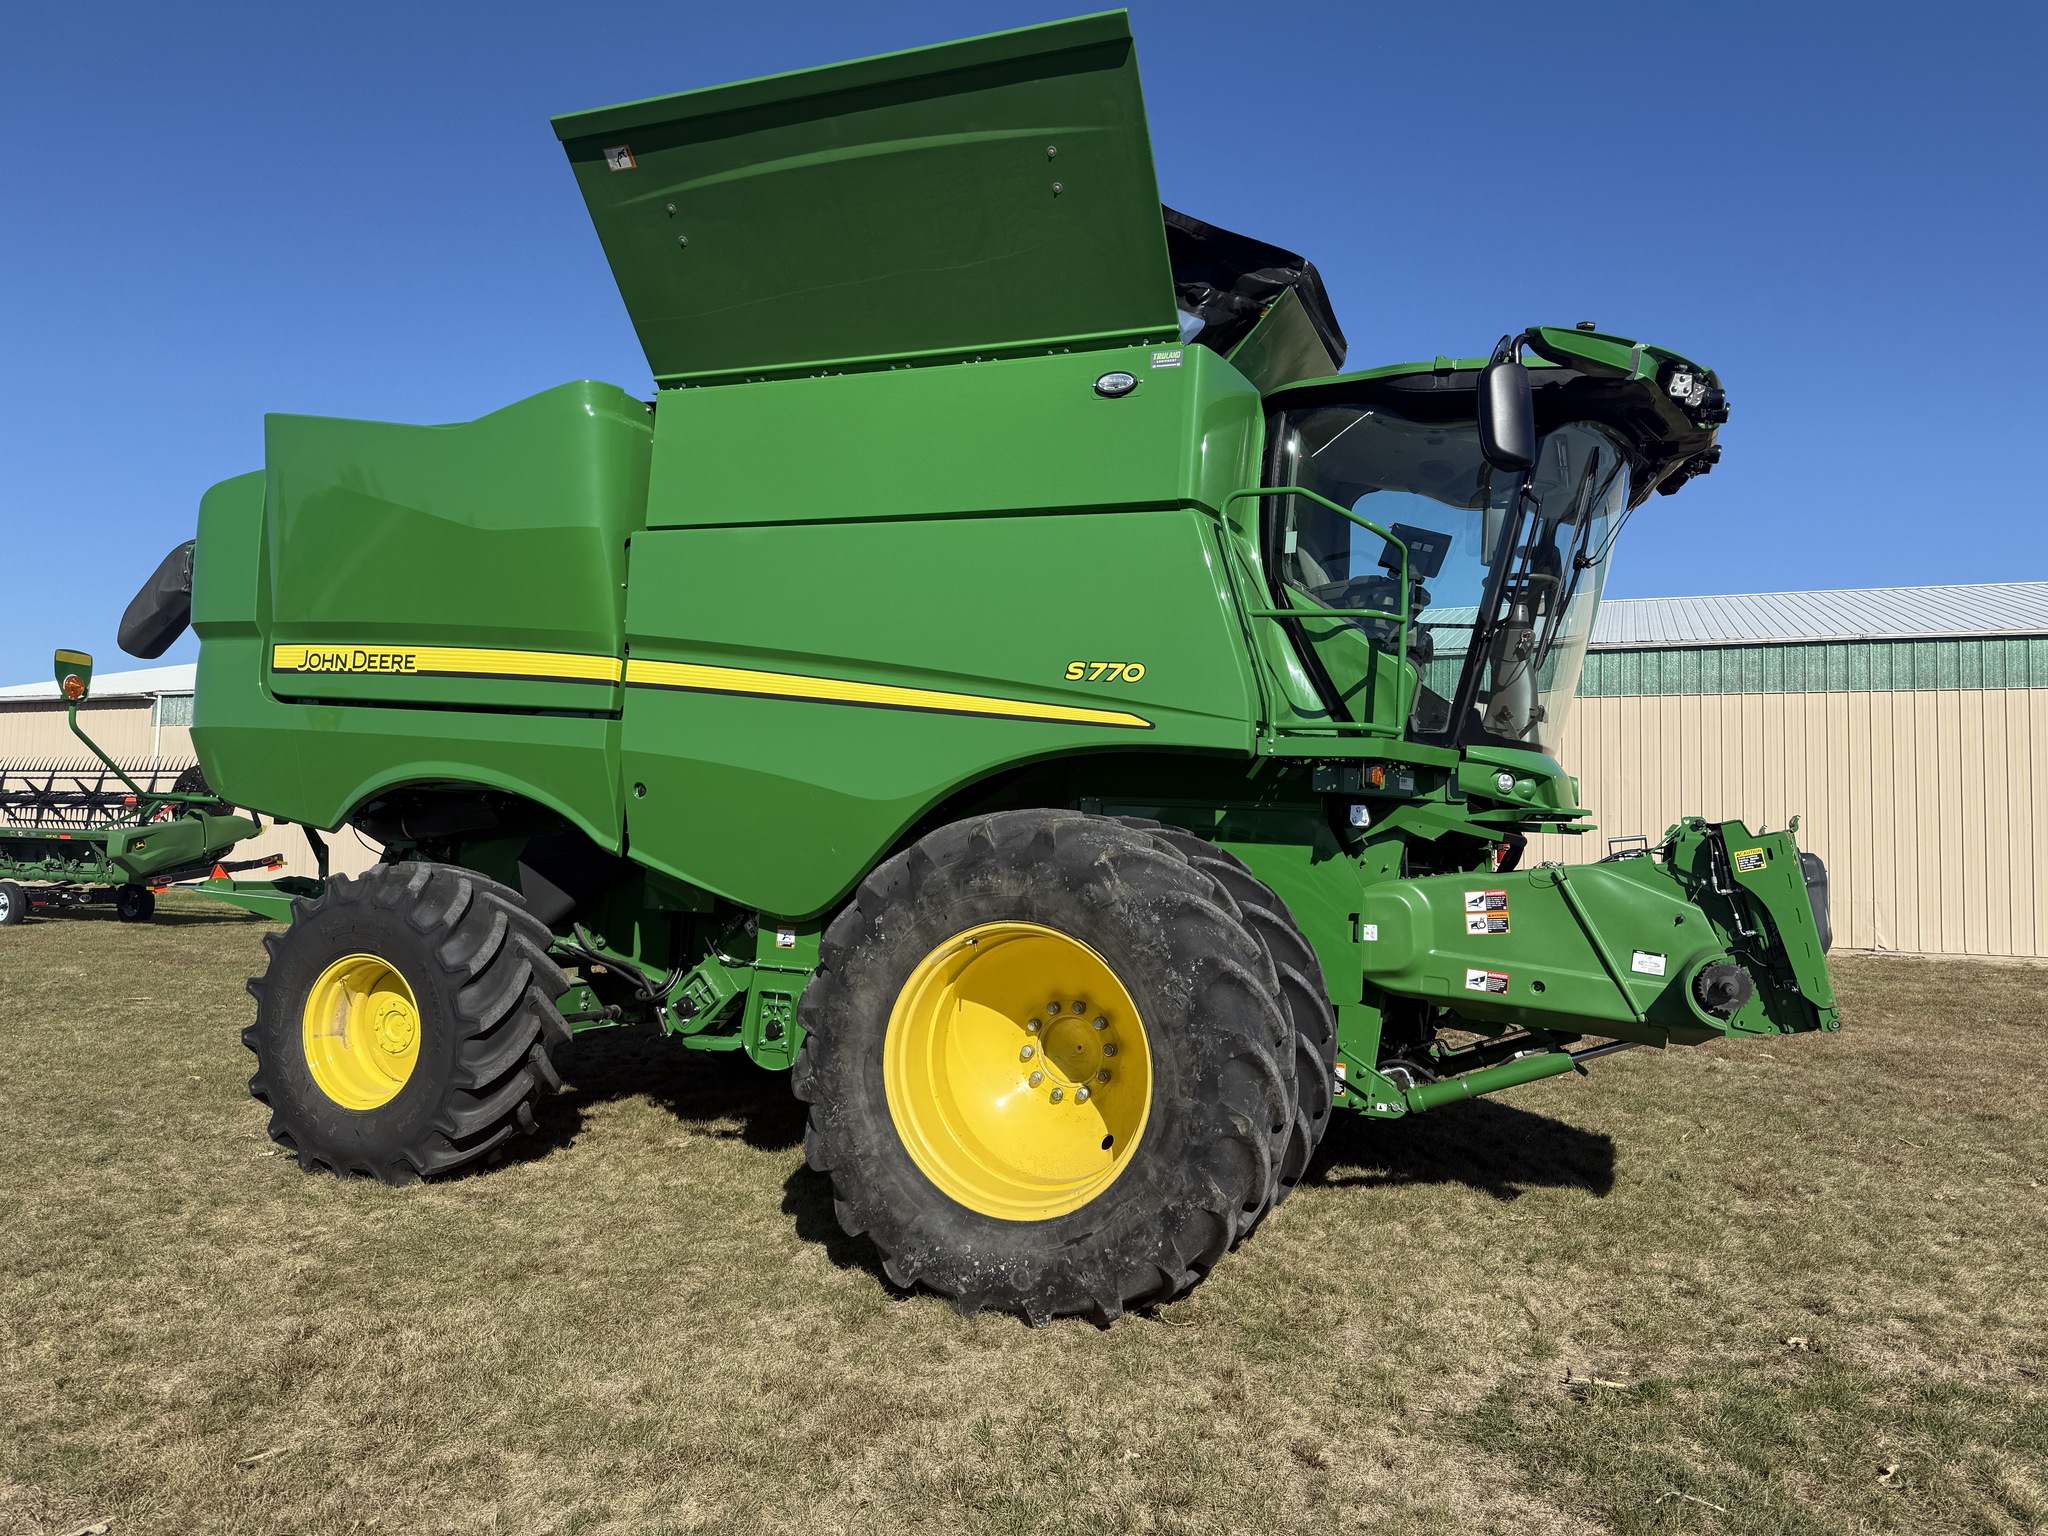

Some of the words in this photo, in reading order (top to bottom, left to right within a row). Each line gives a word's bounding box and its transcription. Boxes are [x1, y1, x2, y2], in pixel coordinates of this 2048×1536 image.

[1153, 351, 1181, 360] TRULAND
[298, 650, 348, 669] JOHN
[353, 650, 416, 670] DEERE
[1064, 661, 1146, 683] S770
[269, 958, 320, 1131] GOODYEAR
